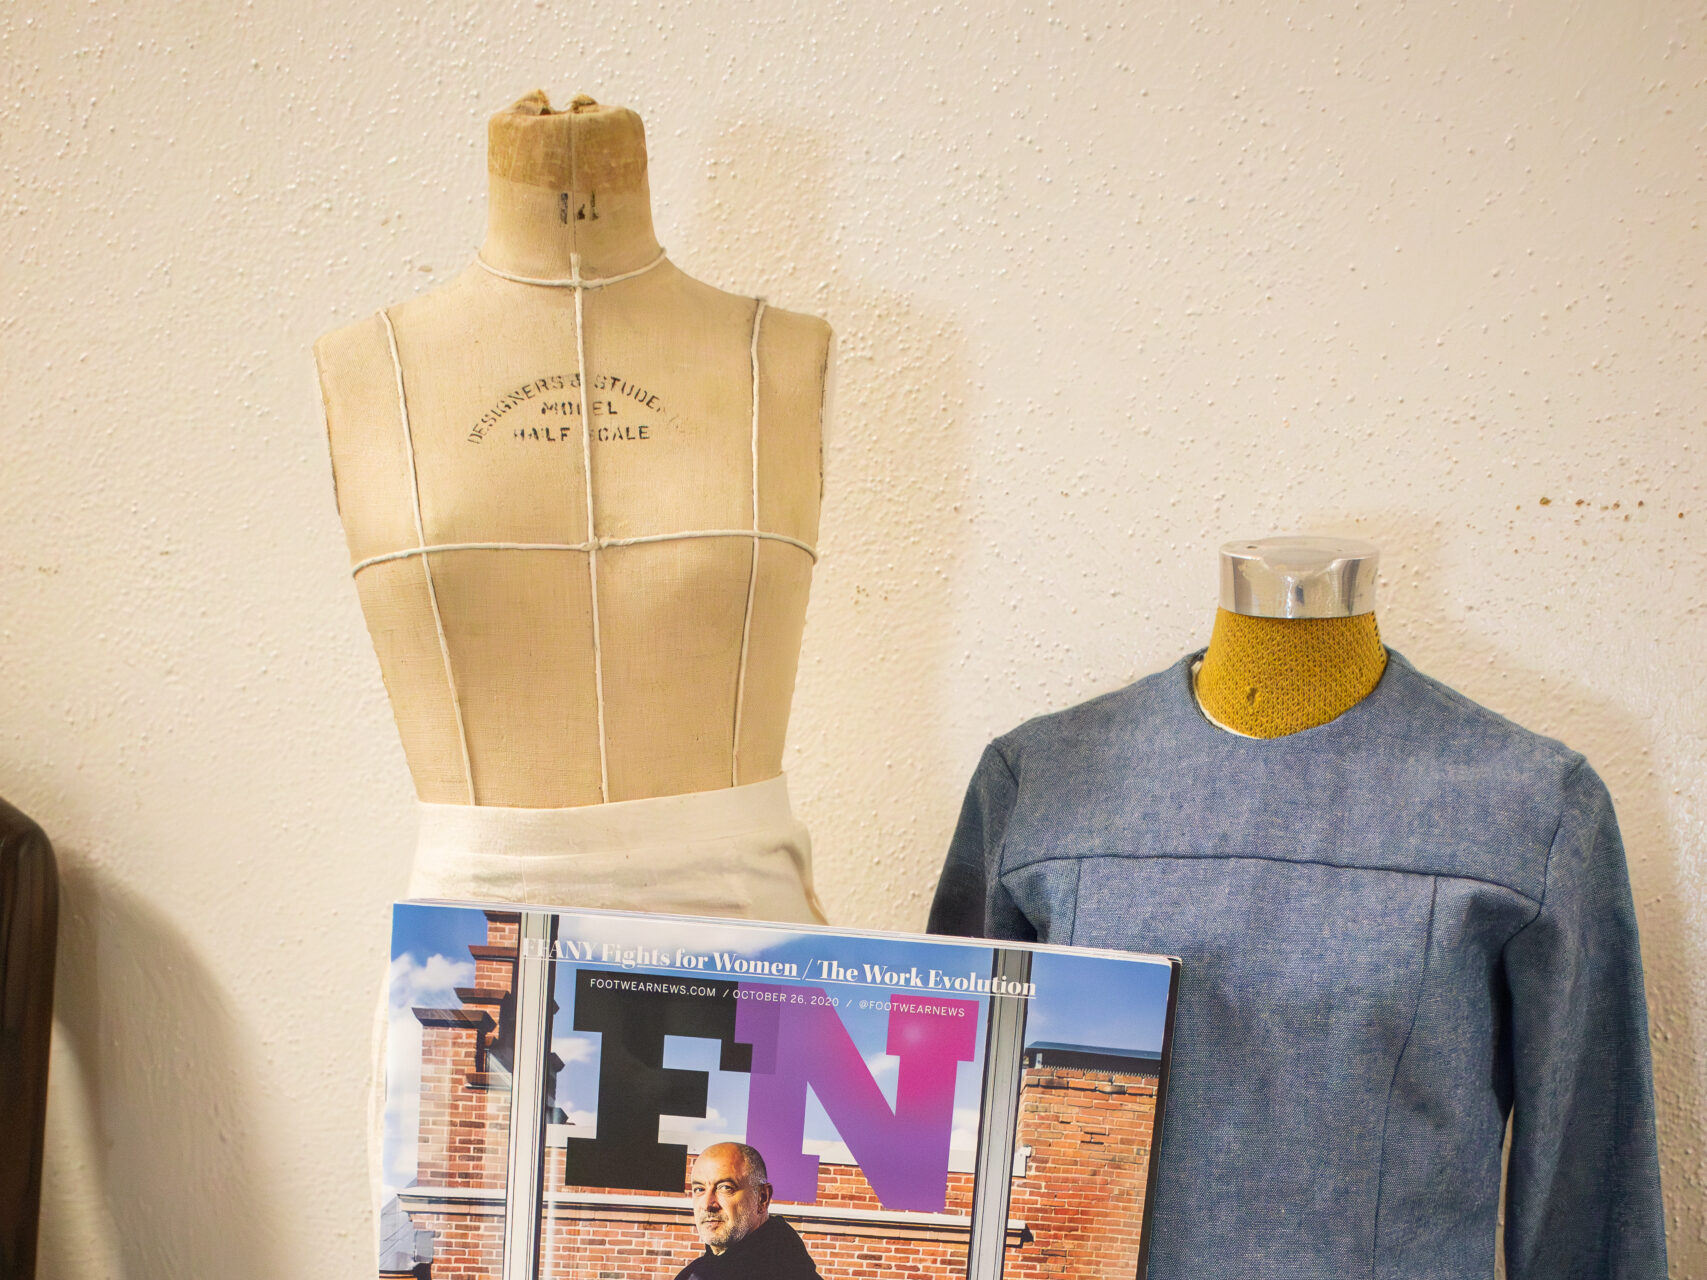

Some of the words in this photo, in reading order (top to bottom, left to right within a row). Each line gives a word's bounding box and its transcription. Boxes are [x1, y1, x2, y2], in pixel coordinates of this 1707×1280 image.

[467, 375, 563, 445] DESIGNERS
[601, 943, 671, 968] Fights
[675, 947, 709, 969] for
[713, 952, 798, 977] Women
[817, 960, 858, 981] The
[863, 964, 923, 987] Work
[928, 969, 1036, 996] Evolution
[590, 979, 716, 997] FOOTWEARNEWS.COM
[732, 990, 787, 1003] OCTOBER
[811, 996, 839, 1008] 2020
[859, 1000, 965, 1018] @FOOTWEARNEWS
